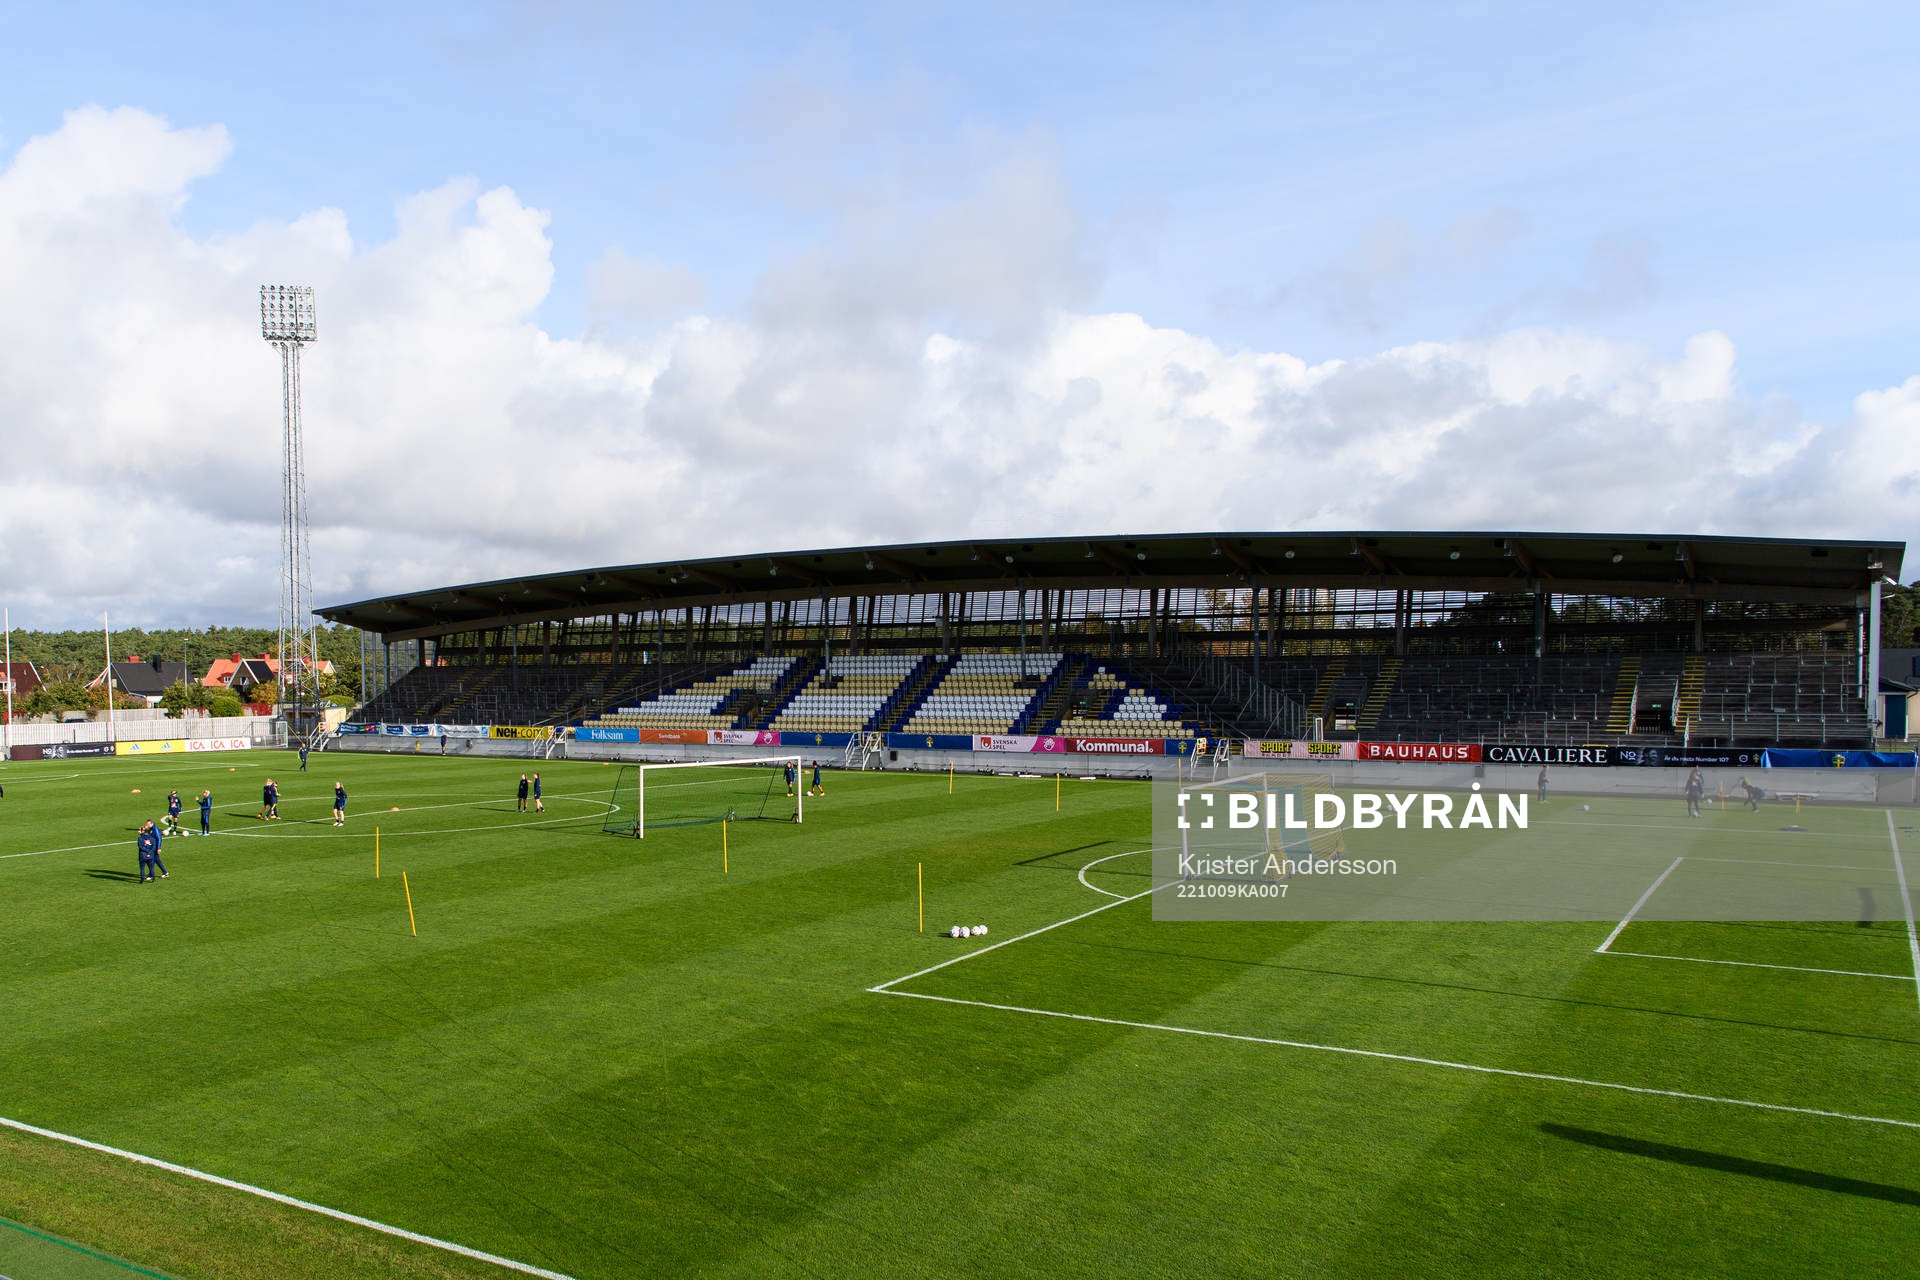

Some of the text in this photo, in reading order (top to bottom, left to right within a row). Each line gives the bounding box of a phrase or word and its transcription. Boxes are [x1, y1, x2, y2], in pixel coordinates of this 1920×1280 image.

[591, 729, 624, 740] Folksam
[189, 741, 205, 750] ICA
[210, 740, 225, 749] ICA
[230, 739, 245, 748] ICA
[1260, 742, 1292, 753] SPORT
[1308, 742, 1341, 754] SPORT
[1370, 745, 1469, 759] BAUHAUS
[1489, 747, 1608, 763] CAVALIERE
